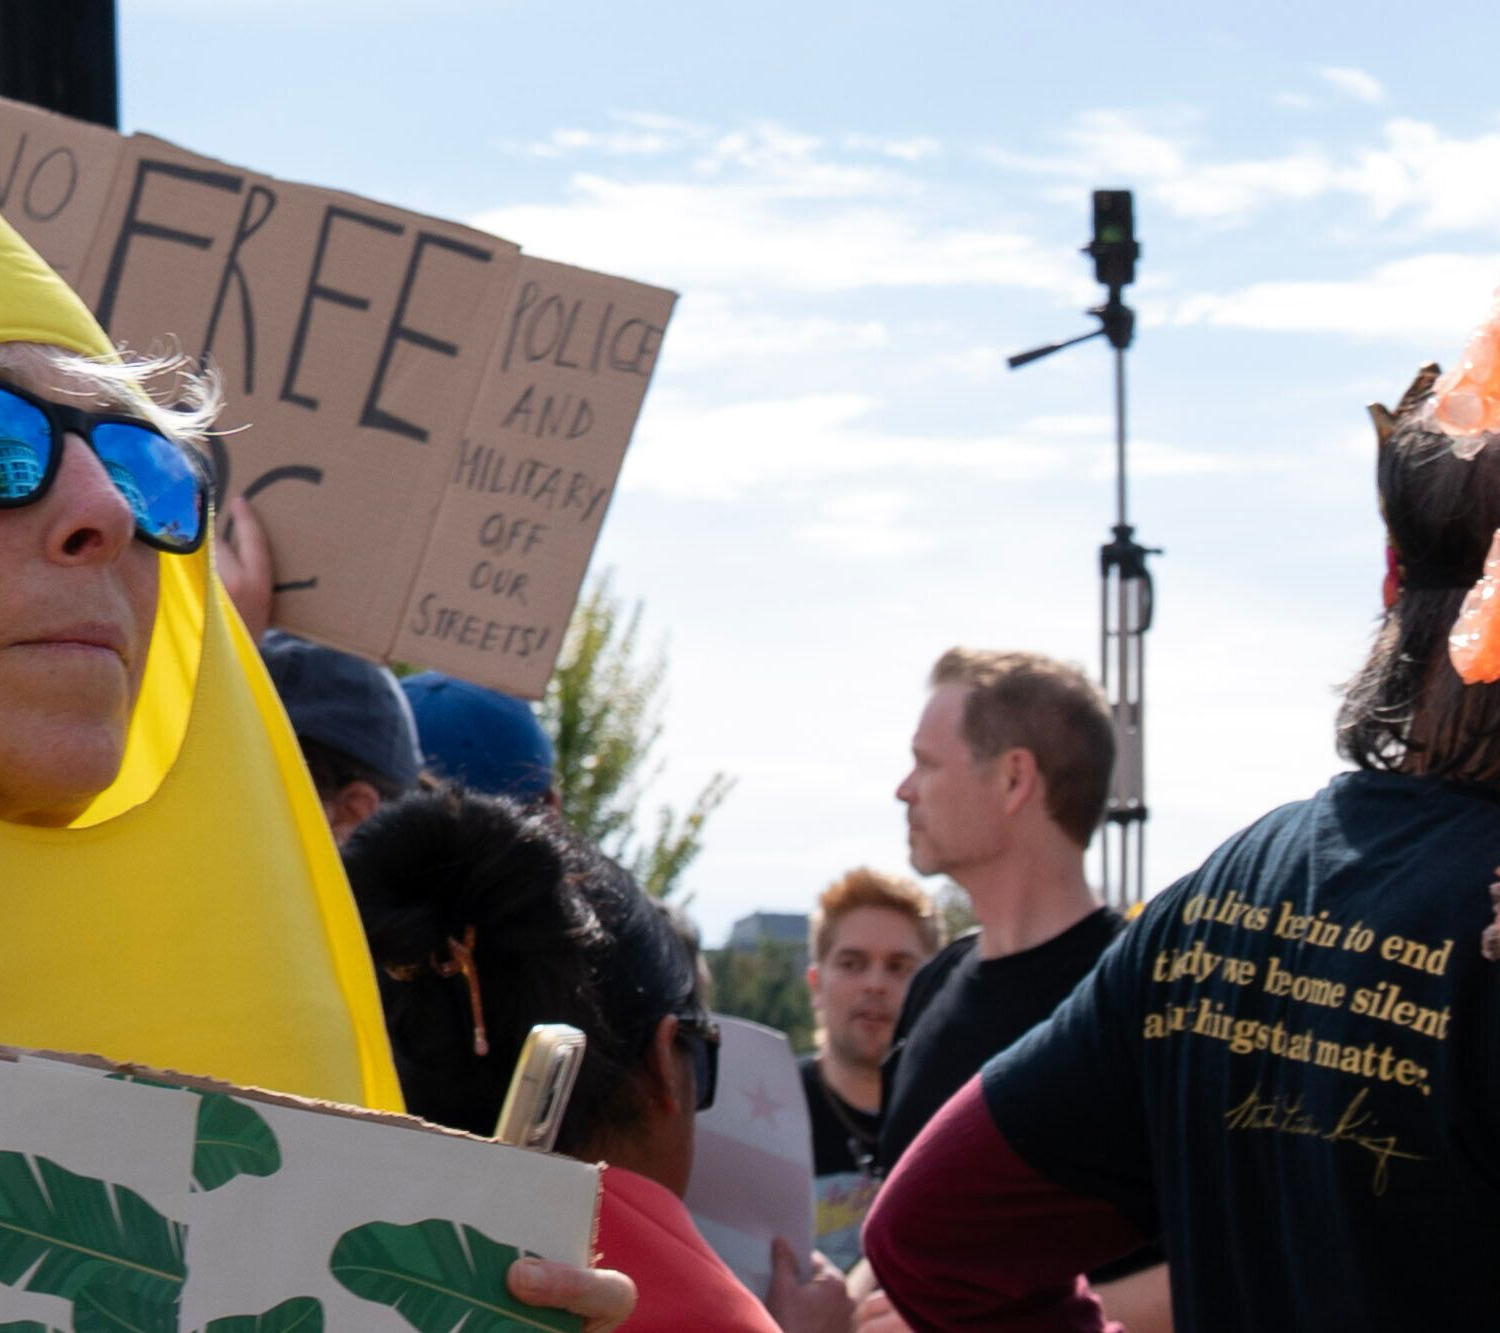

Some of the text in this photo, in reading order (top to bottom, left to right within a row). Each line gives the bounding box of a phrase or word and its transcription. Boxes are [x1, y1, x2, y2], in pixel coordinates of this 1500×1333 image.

[101, 159, 494, 442] FREE
[501, 281, 664, 376] POLICE
[501, 384, 596, 440] AND
[478, 512, 550, 555] OFF
[468, 560, 530, 608] OUR
[1381, 934, 1454, 976] end
[1263, 956, 1346, 1009] beome
[1350, 980, 1452, 1040] silent
